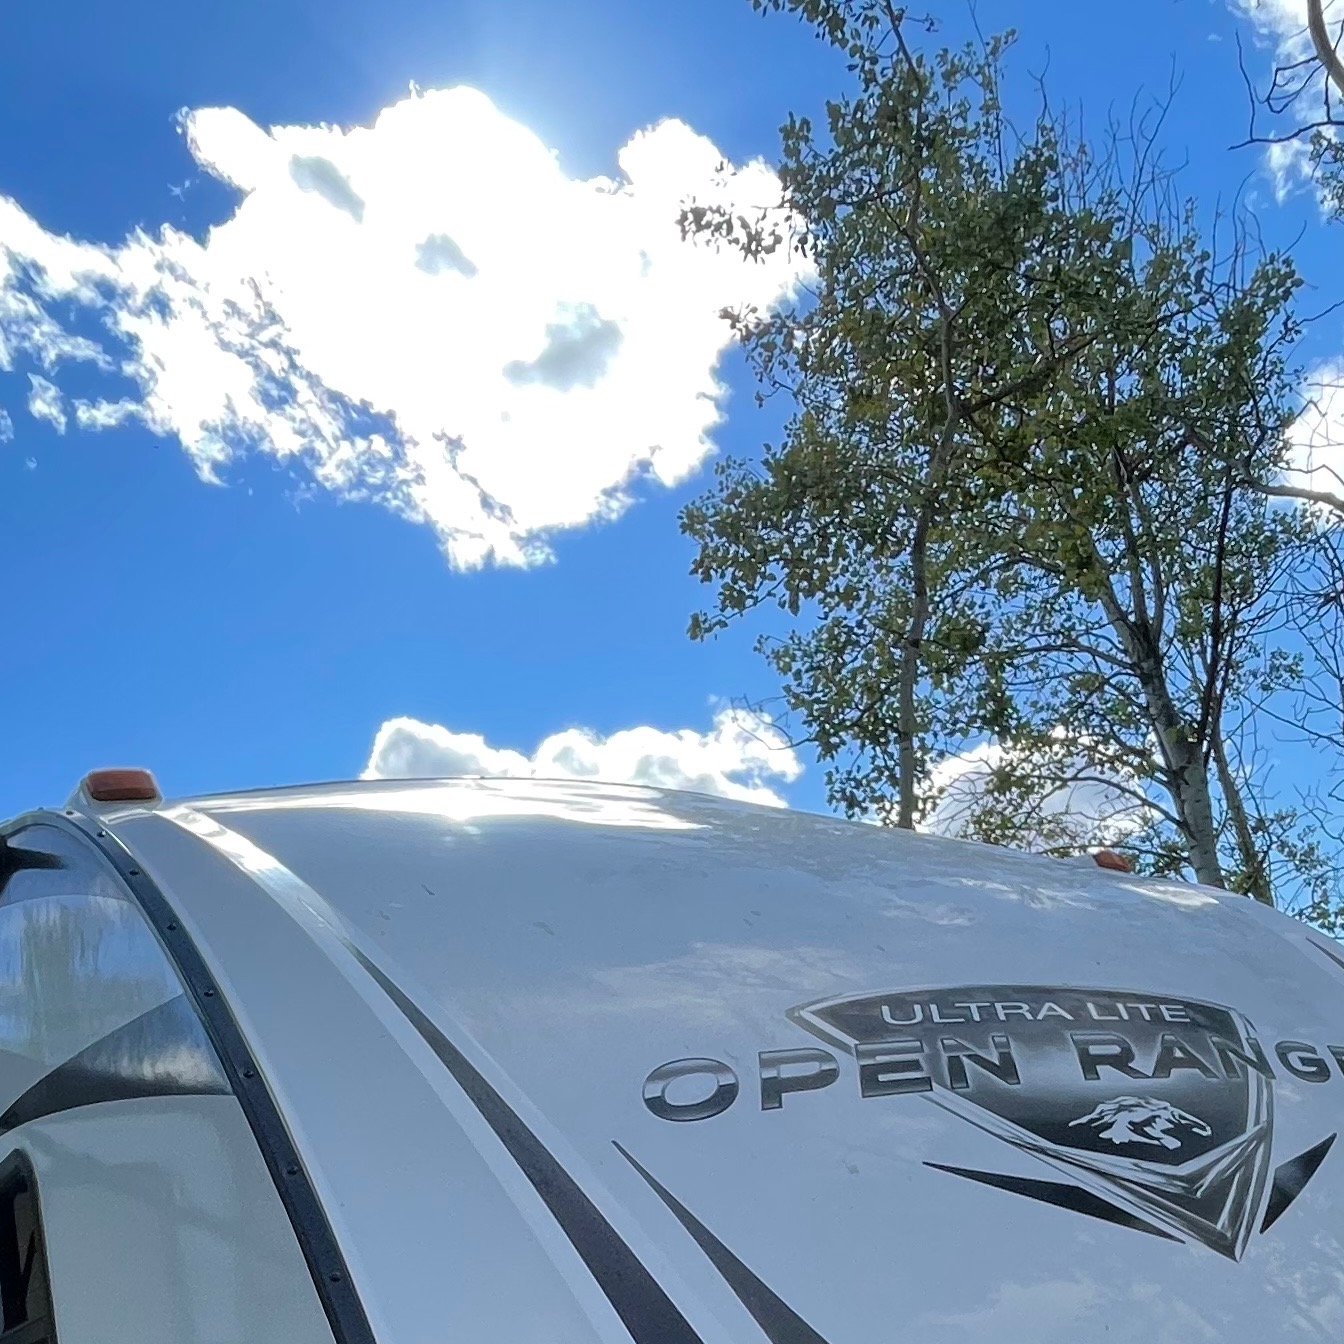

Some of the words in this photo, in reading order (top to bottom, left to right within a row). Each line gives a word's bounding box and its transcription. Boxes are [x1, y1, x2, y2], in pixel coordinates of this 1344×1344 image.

[880, 1001, 1076, 1025] ULTRA
[1086, 1002, 1192, 1023] LITE
[641, 1034, 1022, 1122] OPEN
